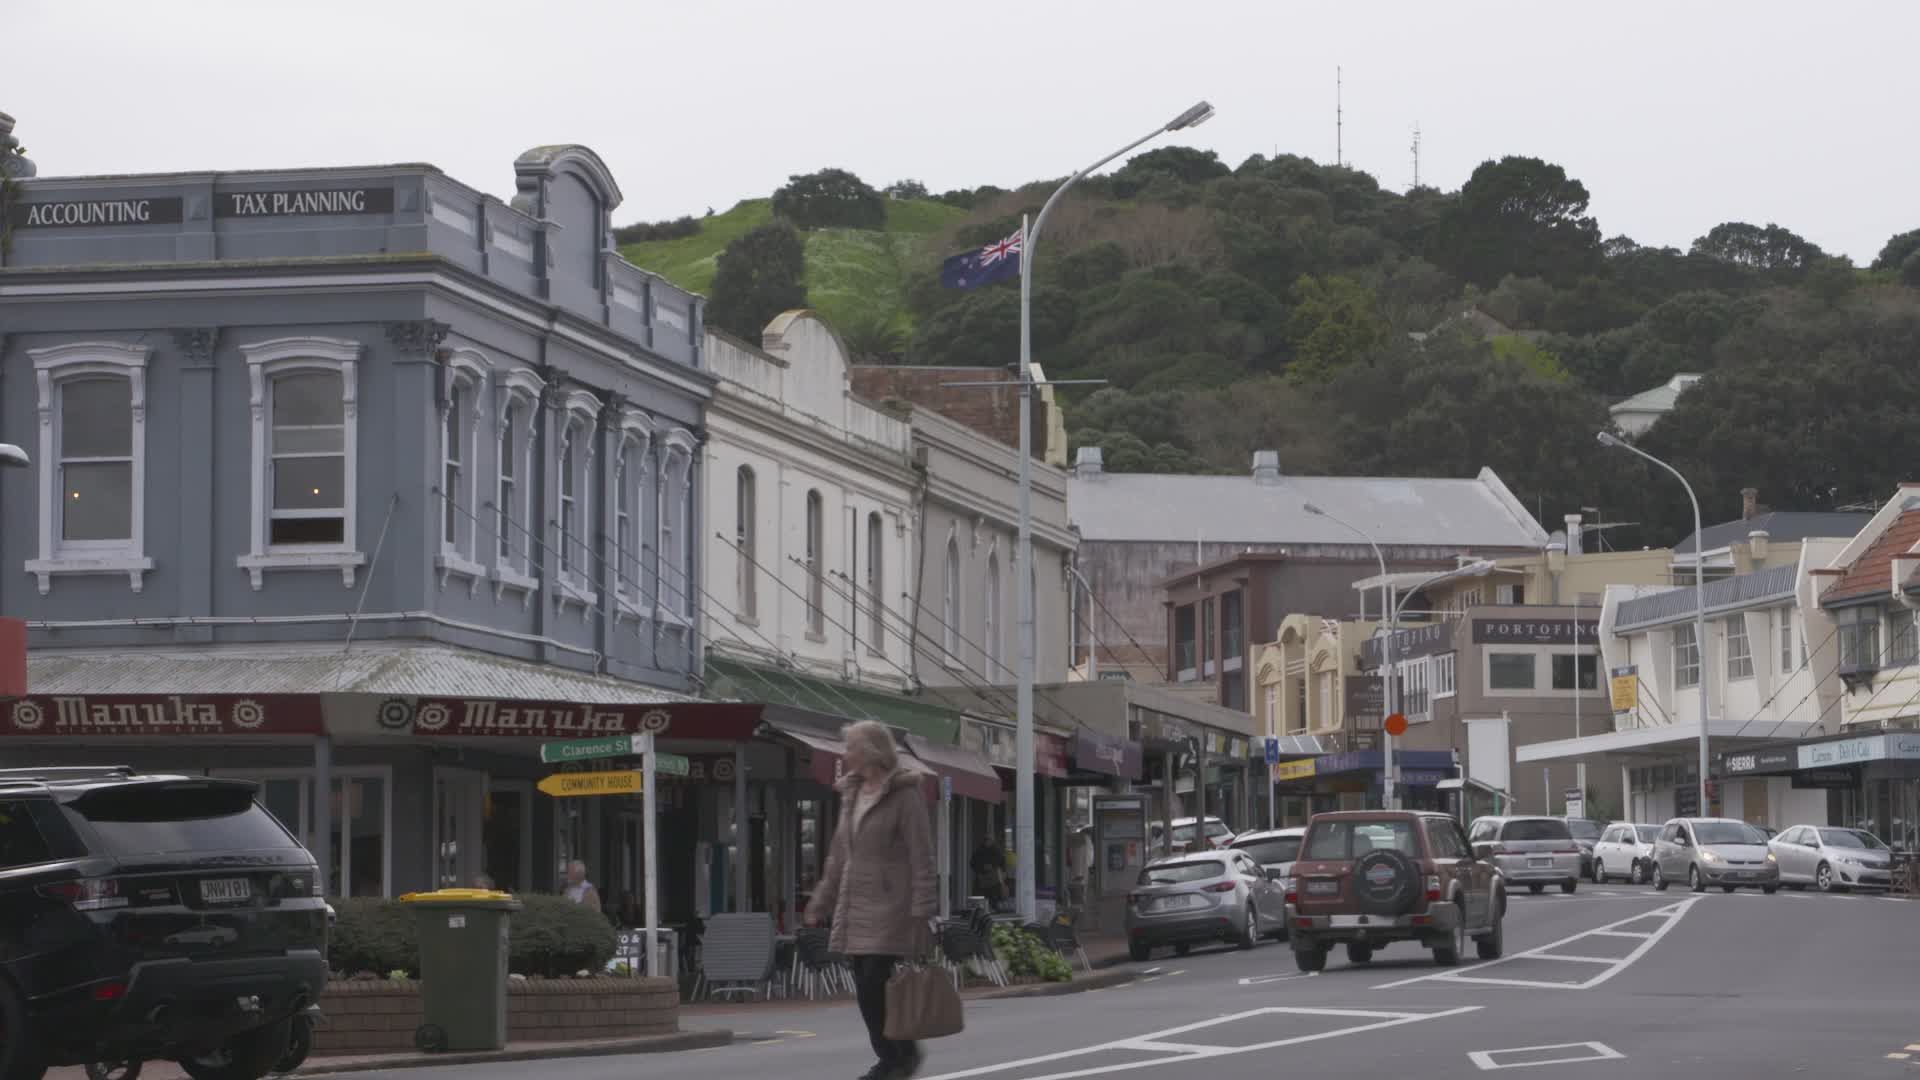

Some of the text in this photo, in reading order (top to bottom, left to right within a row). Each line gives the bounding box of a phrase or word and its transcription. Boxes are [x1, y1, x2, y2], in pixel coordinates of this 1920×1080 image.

[28, 201, 149, 224] ACCOUNTING
[232, 191, 365, 214] TAX PLANNING
[53, 697, 222, 725] Manuka
[460, 701, 625, 731] Manuka
[562, 740, 628, 757] Clarence St
[1732, 755, 1756, 771] SIERRA
[561, 775, 633, 791] COMMUNITY HOUSE
